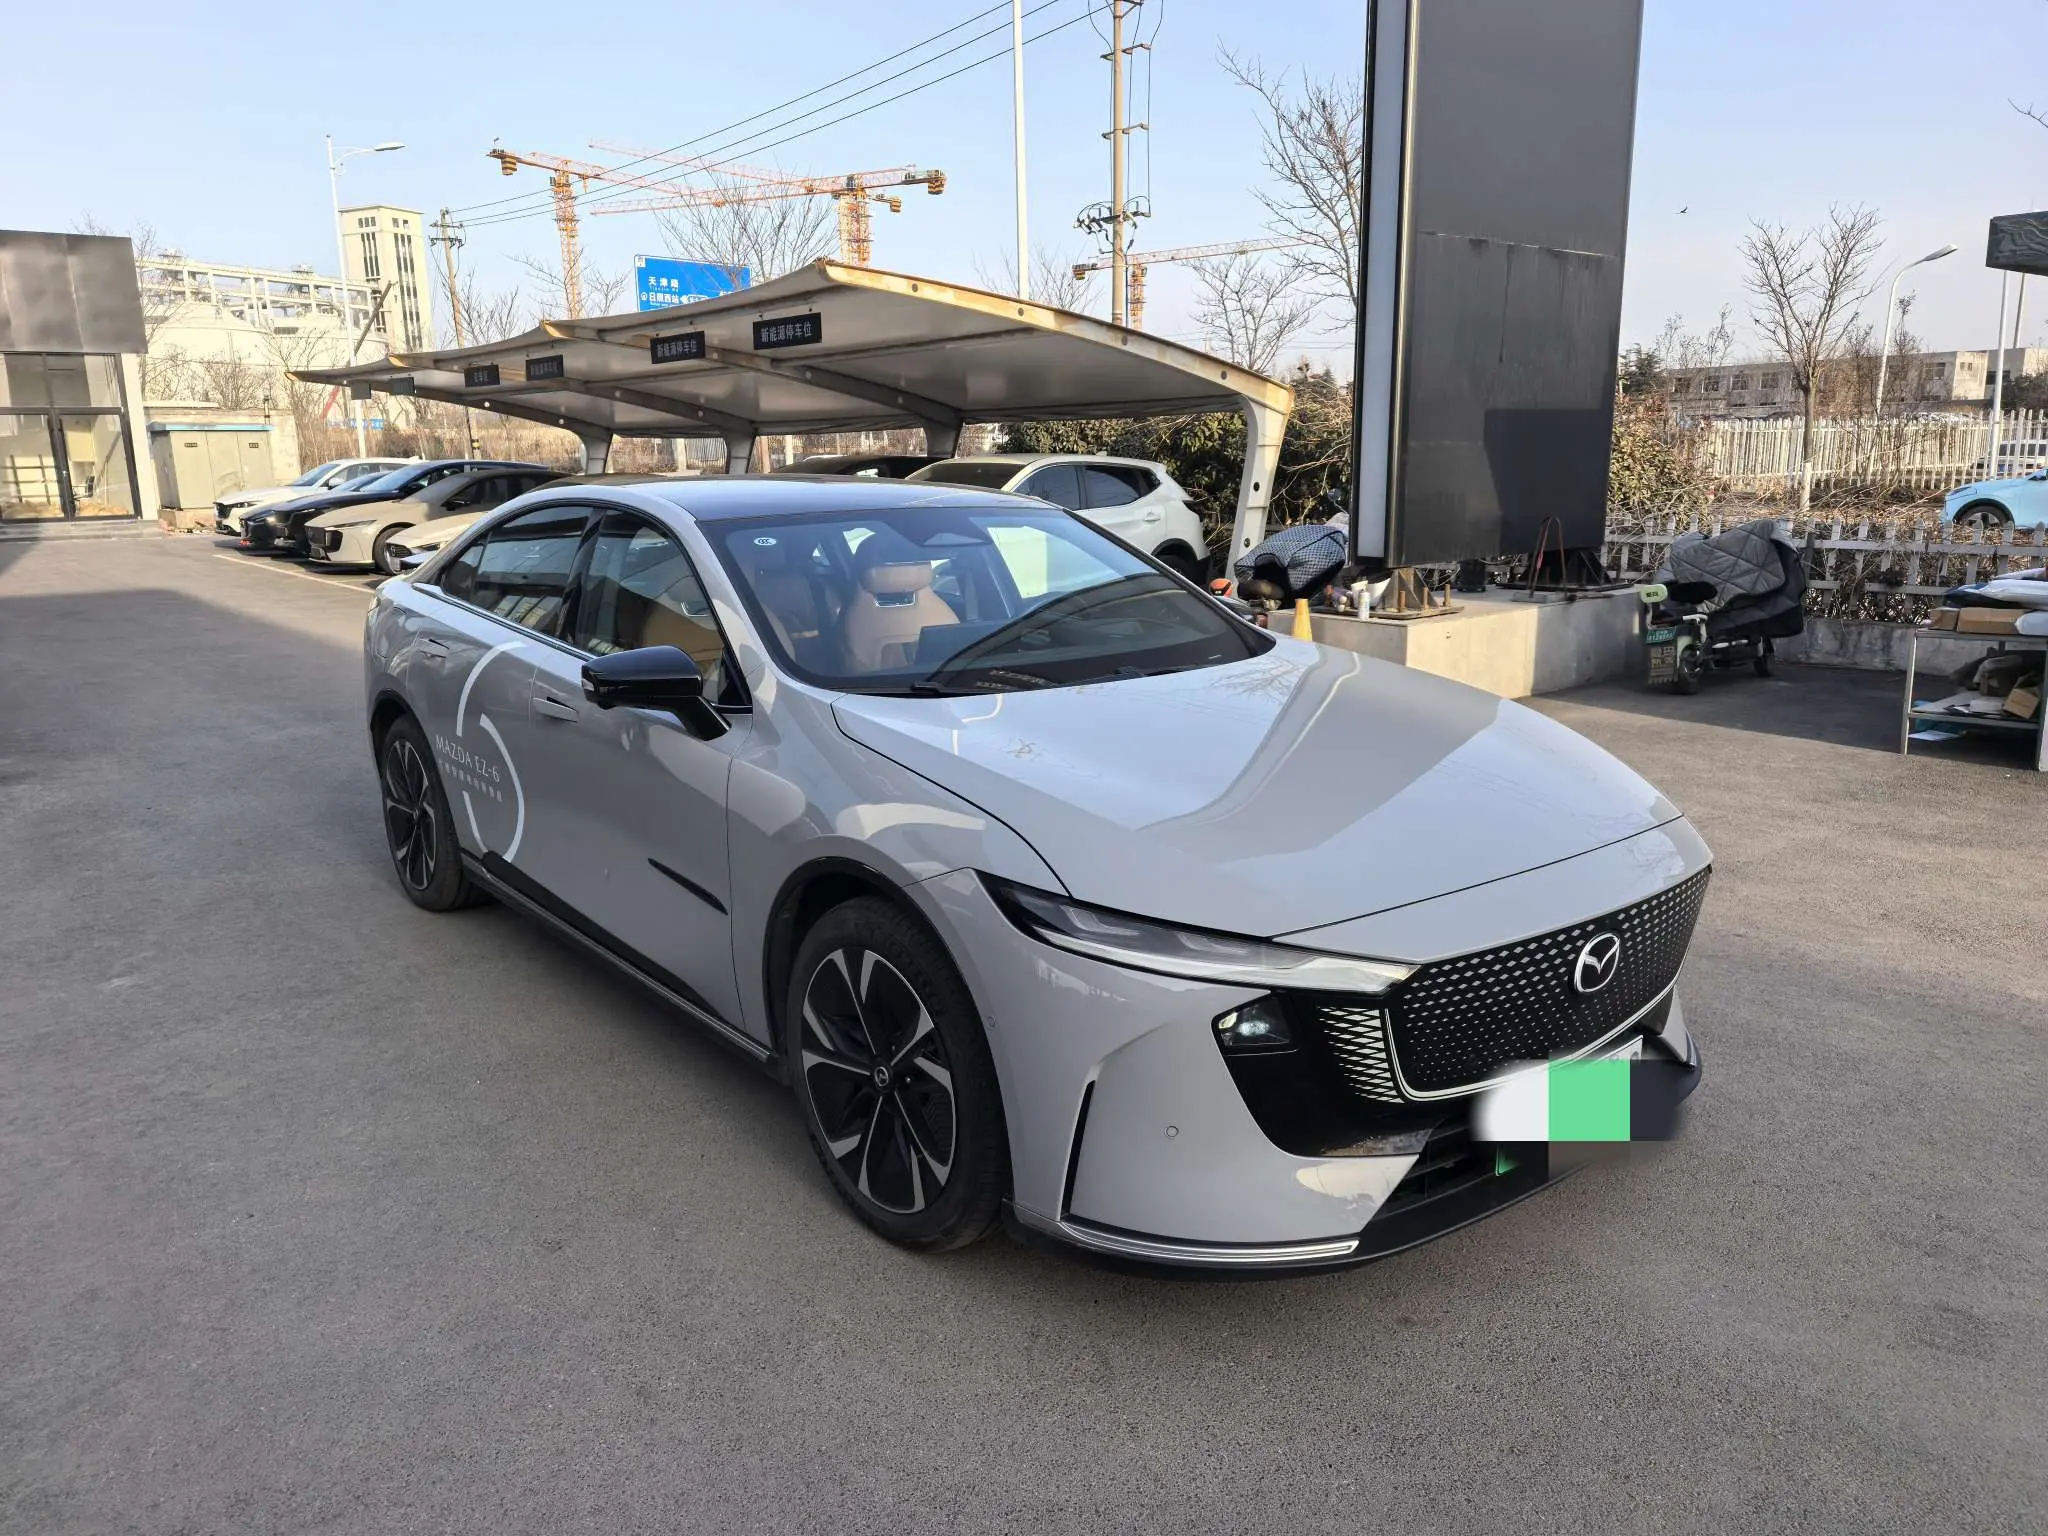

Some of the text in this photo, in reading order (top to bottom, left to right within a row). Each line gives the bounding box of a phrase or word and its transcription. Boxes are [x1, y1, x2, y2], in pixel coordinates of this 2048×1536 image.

[761, 321, 813, 342] 新能源停车位
[436, 734, 473, 769] MAZDA
